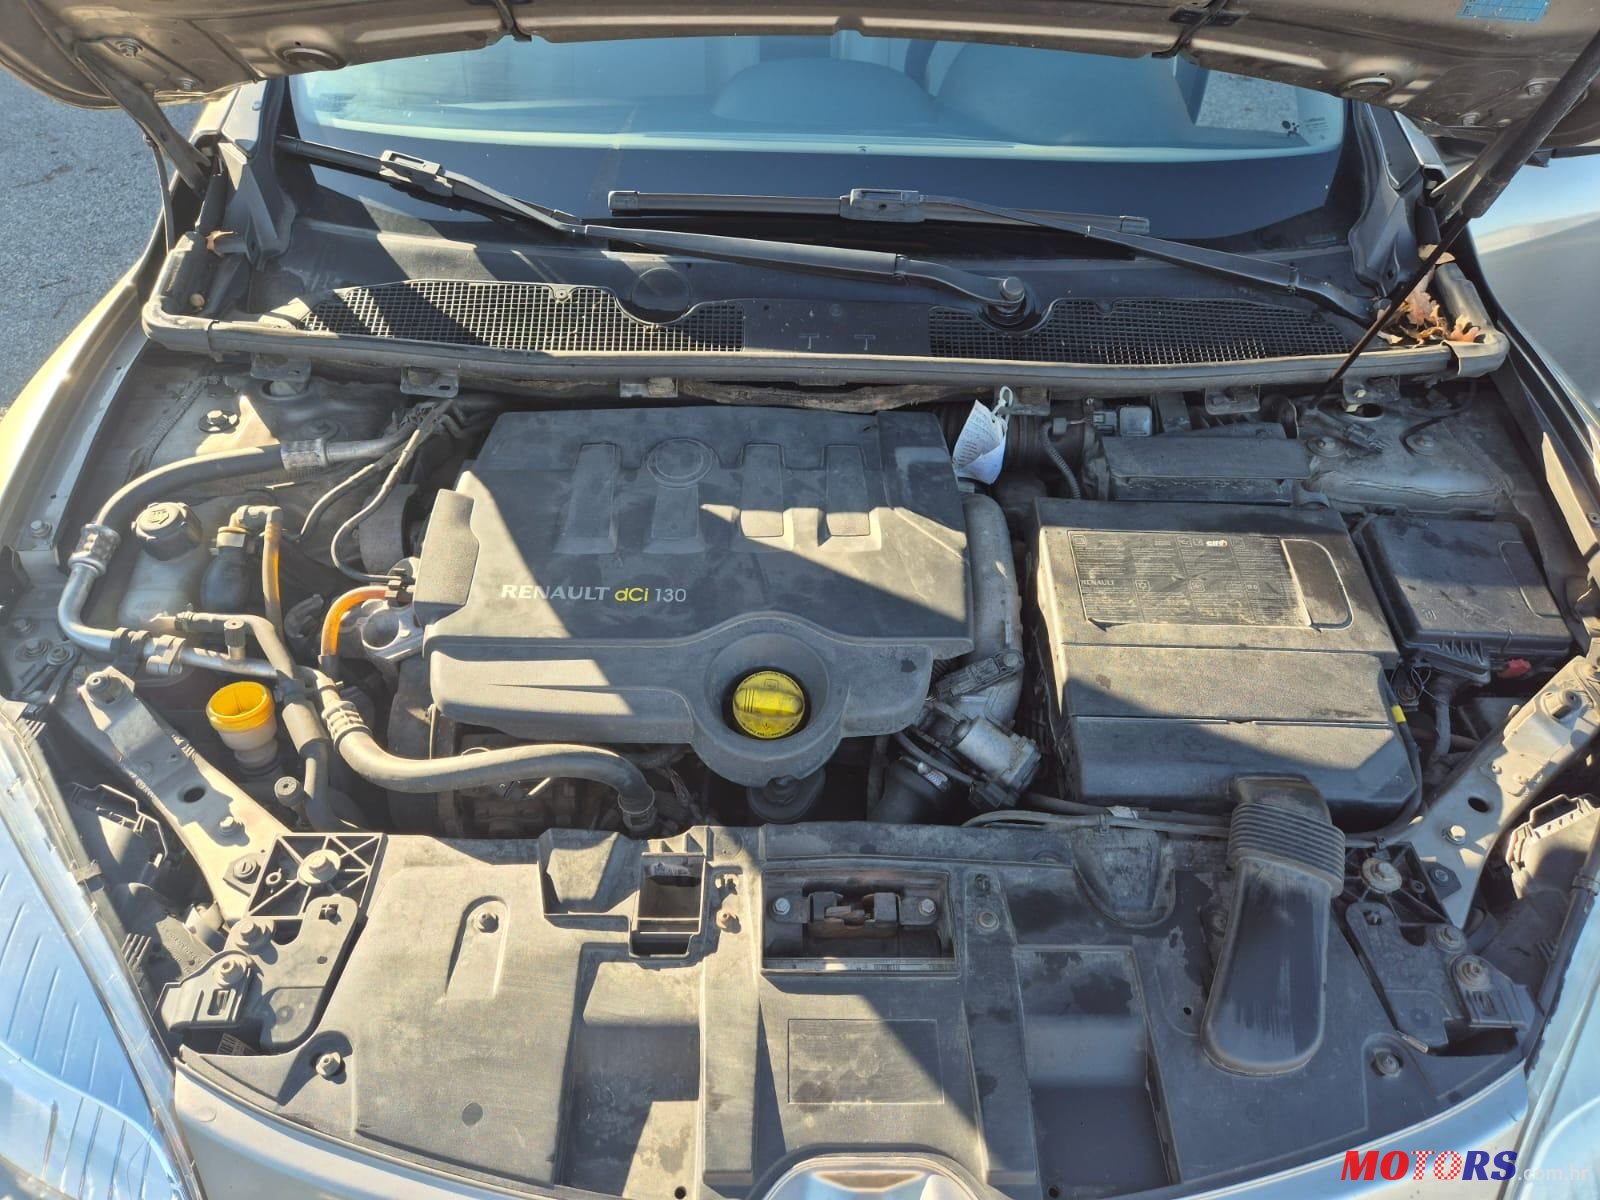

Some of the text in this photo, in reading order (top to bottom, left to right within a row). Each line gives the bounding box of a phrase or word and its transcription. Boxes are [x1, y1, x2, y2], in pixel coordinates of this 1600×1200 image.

[500, 584, 687, 603] RENAULT dCi 130
